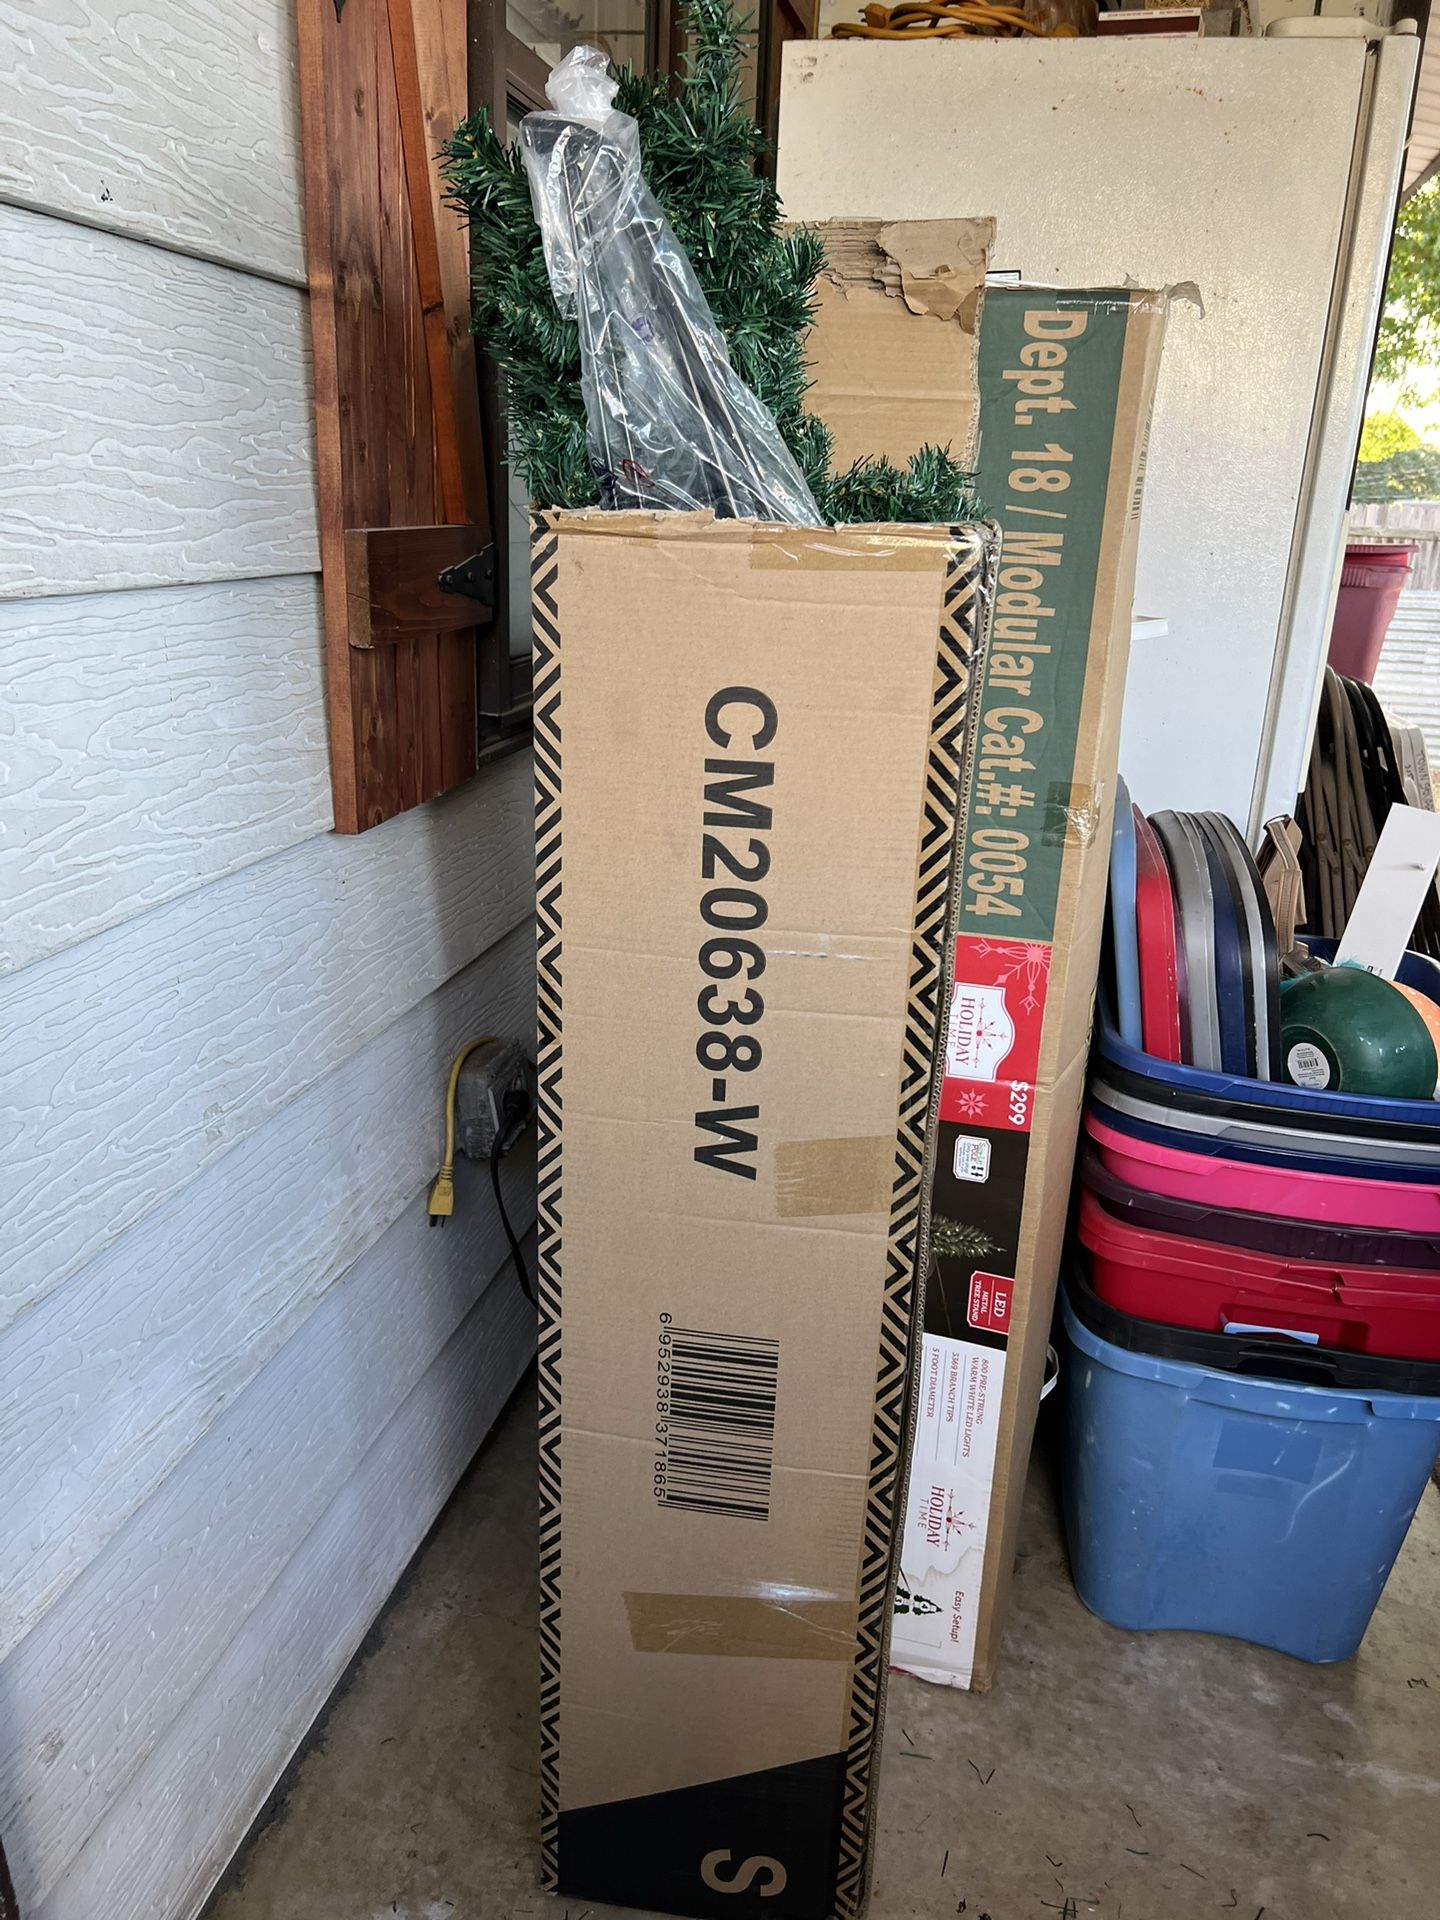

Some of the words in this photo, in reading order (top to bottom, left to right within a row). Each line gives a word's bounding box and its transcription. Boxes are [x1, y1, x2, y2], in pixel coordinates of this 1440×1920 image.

[1003, 310, 1088, 426] Dept.
[1008, 443, 1073, 493] 18
[1005, 505, 1067, 519] /
[988, 531, 1064, 697] Modular
[974, 708, 1044, 817] Cat.#:
[965, 829, 1030, 918] 0054
[694, 686, 778, 1181] CM20638-W
[955, 997, 976, 1066] HOLIDAY
[1008, 1079, 1030, 1126] $299
[971, 1299, 980, 1321] STAND
[980, 1290, 989, 1314] METAL
[994, 1291, 1007, 1317] LED
[659, 1312, 672, 1324] 6
[656, 1334, 671, 1413] 952938
[930, 1353, 939, 1376] FOOT
[951, 1351, 960, 1370] 3369
[969, 1356, 979, 1383] WARM
[980, 1358, 989, 1374] 800
[926, 1376, 937, 1418] DIAMETER
[948, 1371, 958, 1404] BRANCH
[966, 1384, 976, 1411] WHITE
[975, 1374, 987, 1425] PRE-STRUNG
[946, 1405, 954, 1423] TIPS
[965, 1411, 973, 1428] LED
[962, 1428, 971, 1458] LIGHTS
[653, 1423, 669, 1498] 371865
[917, 1498, 929, 1529] TIME
[926, 1486, 945, 1548] HOLIDAY
[951, 1590, 965, 1613] Easy
[949, 1613, 962, 1643] Setup!
[700, 1848, 787, 1897] S
